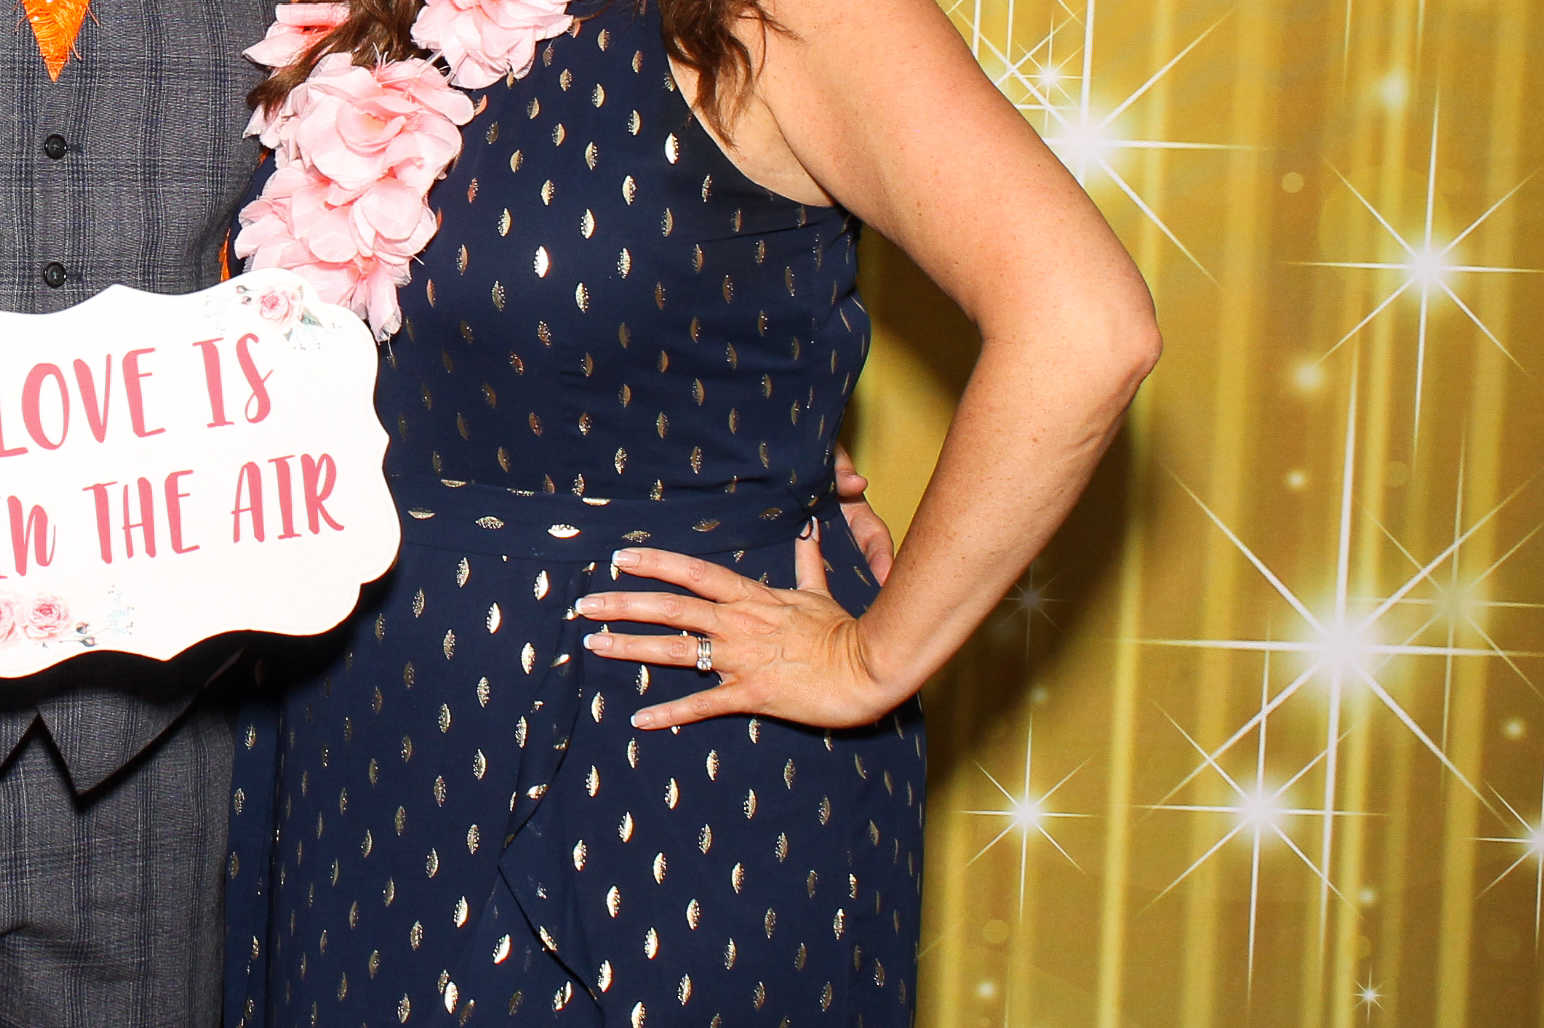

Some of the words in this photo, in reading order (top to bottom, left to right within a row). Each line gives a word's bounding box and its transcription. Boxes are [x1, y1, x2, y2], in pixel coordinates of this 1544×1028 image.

[192, 332, 274, 428] IS
[82, 468, 201, 565] THE
[230, 453, 345, 544] AIR
